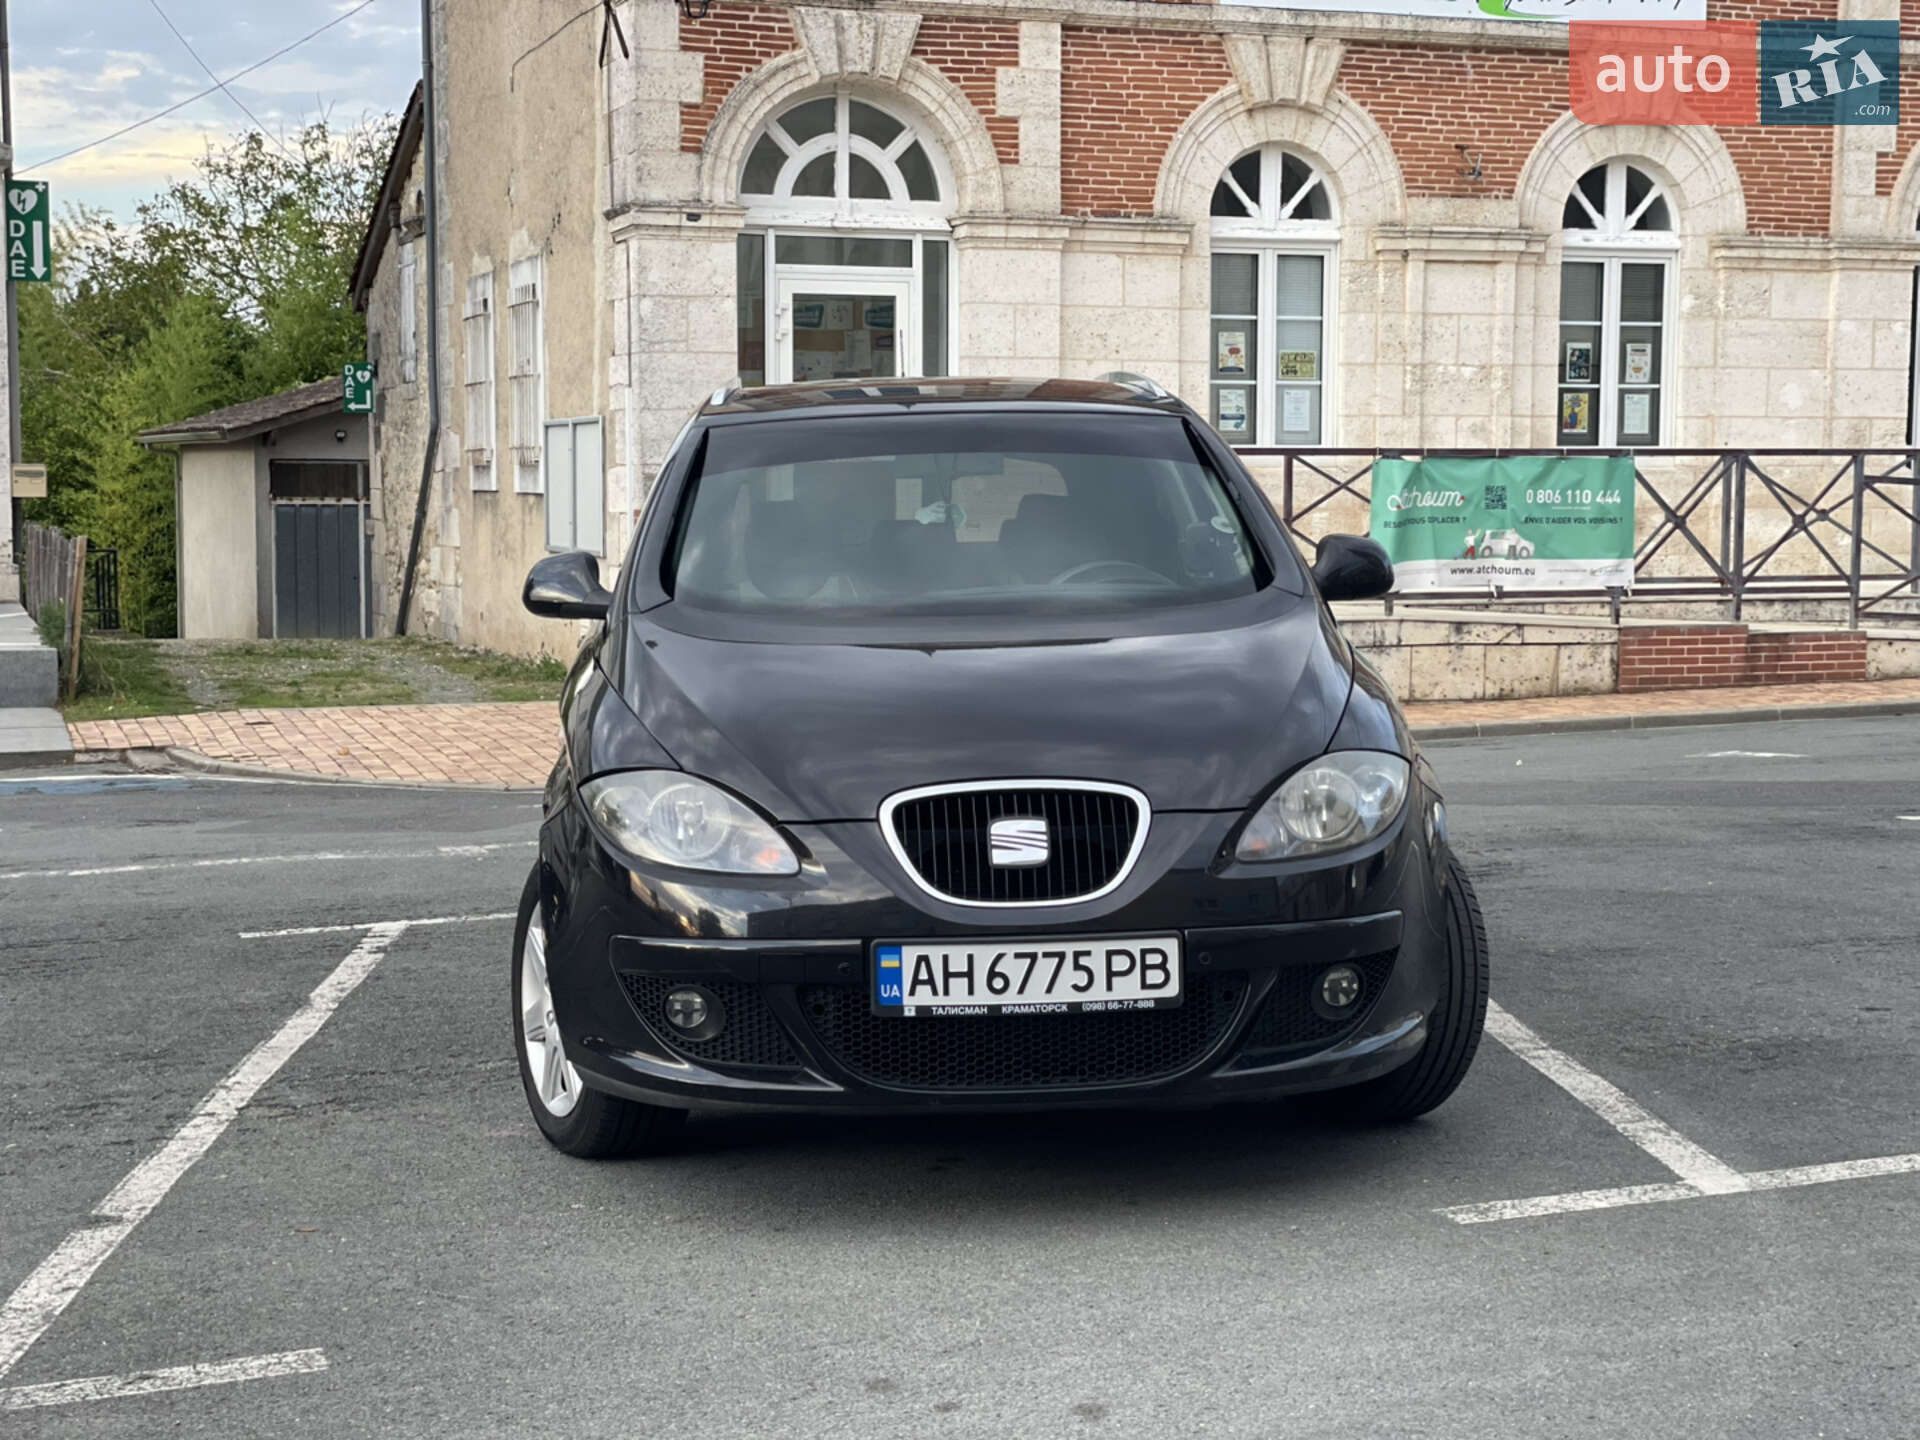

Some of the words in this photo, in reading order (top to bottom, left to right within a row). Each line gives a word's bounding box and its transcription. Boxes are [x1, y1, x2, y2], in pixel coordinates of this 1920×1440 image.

[9, 220, 27, 278] DAE
[344, 364, 355, 399] DAE
[1526, 489, 1534, 504] 0
[1536, 489, 1562, 504] 806
[1566, 489, 1592, 504] 110
[1596, 489, 1621, 504] 444
[1450, 563, 1536, 577] www.atchoum.eu
[880, 984, 901, 998] UA
[931, 1006, 988, 1016] ТАЛИСМАН
[1001, 1003, 1068, 1014] КРАМАТОРСК
